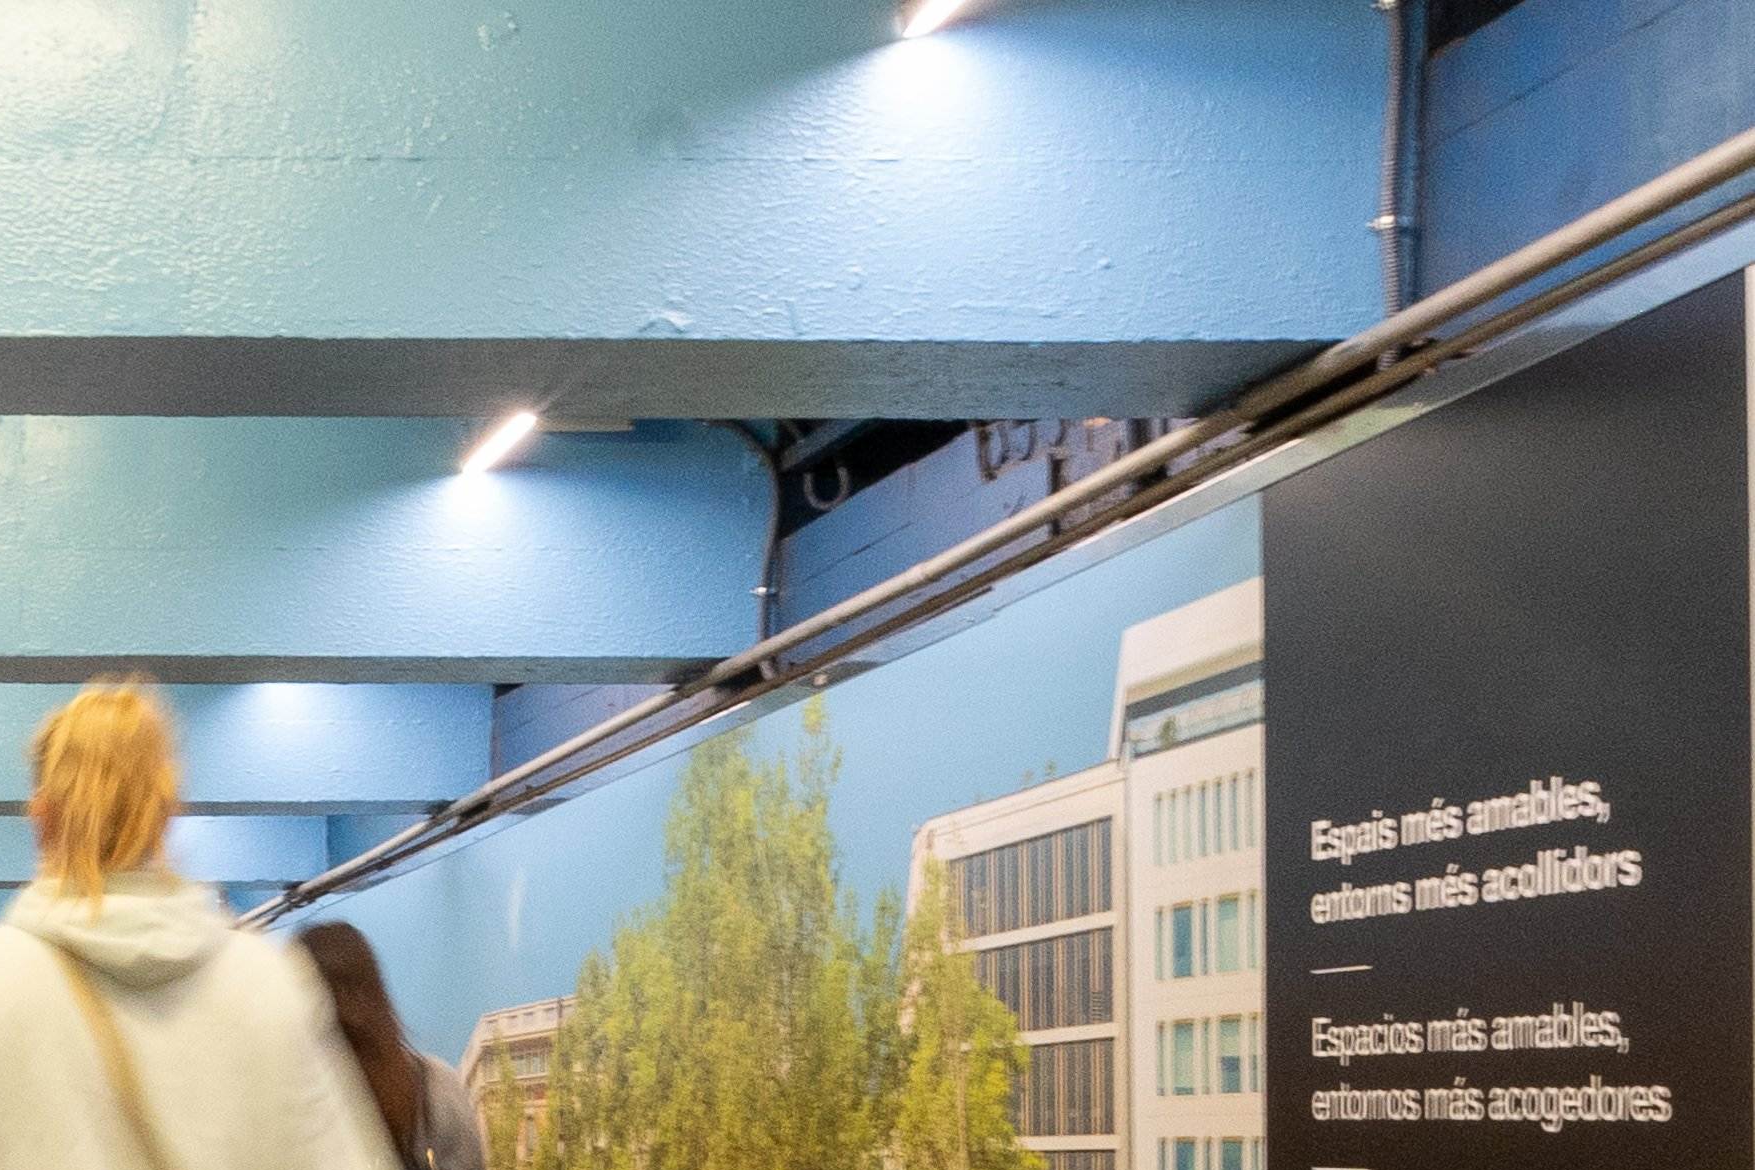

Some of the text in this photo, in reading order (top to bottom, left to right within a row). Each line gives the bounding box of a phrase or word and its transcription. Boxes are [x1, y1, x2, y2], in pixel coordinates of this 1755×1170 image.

[1311, 775, 1611, 865] Espais més amables,
[1311, 845, 1642, 924] entorns més acollidors
[1311, 1001, 1630, 1066] Espacios más amables,
[1311, 1074, 1672, 1133] entornos más acogedores
